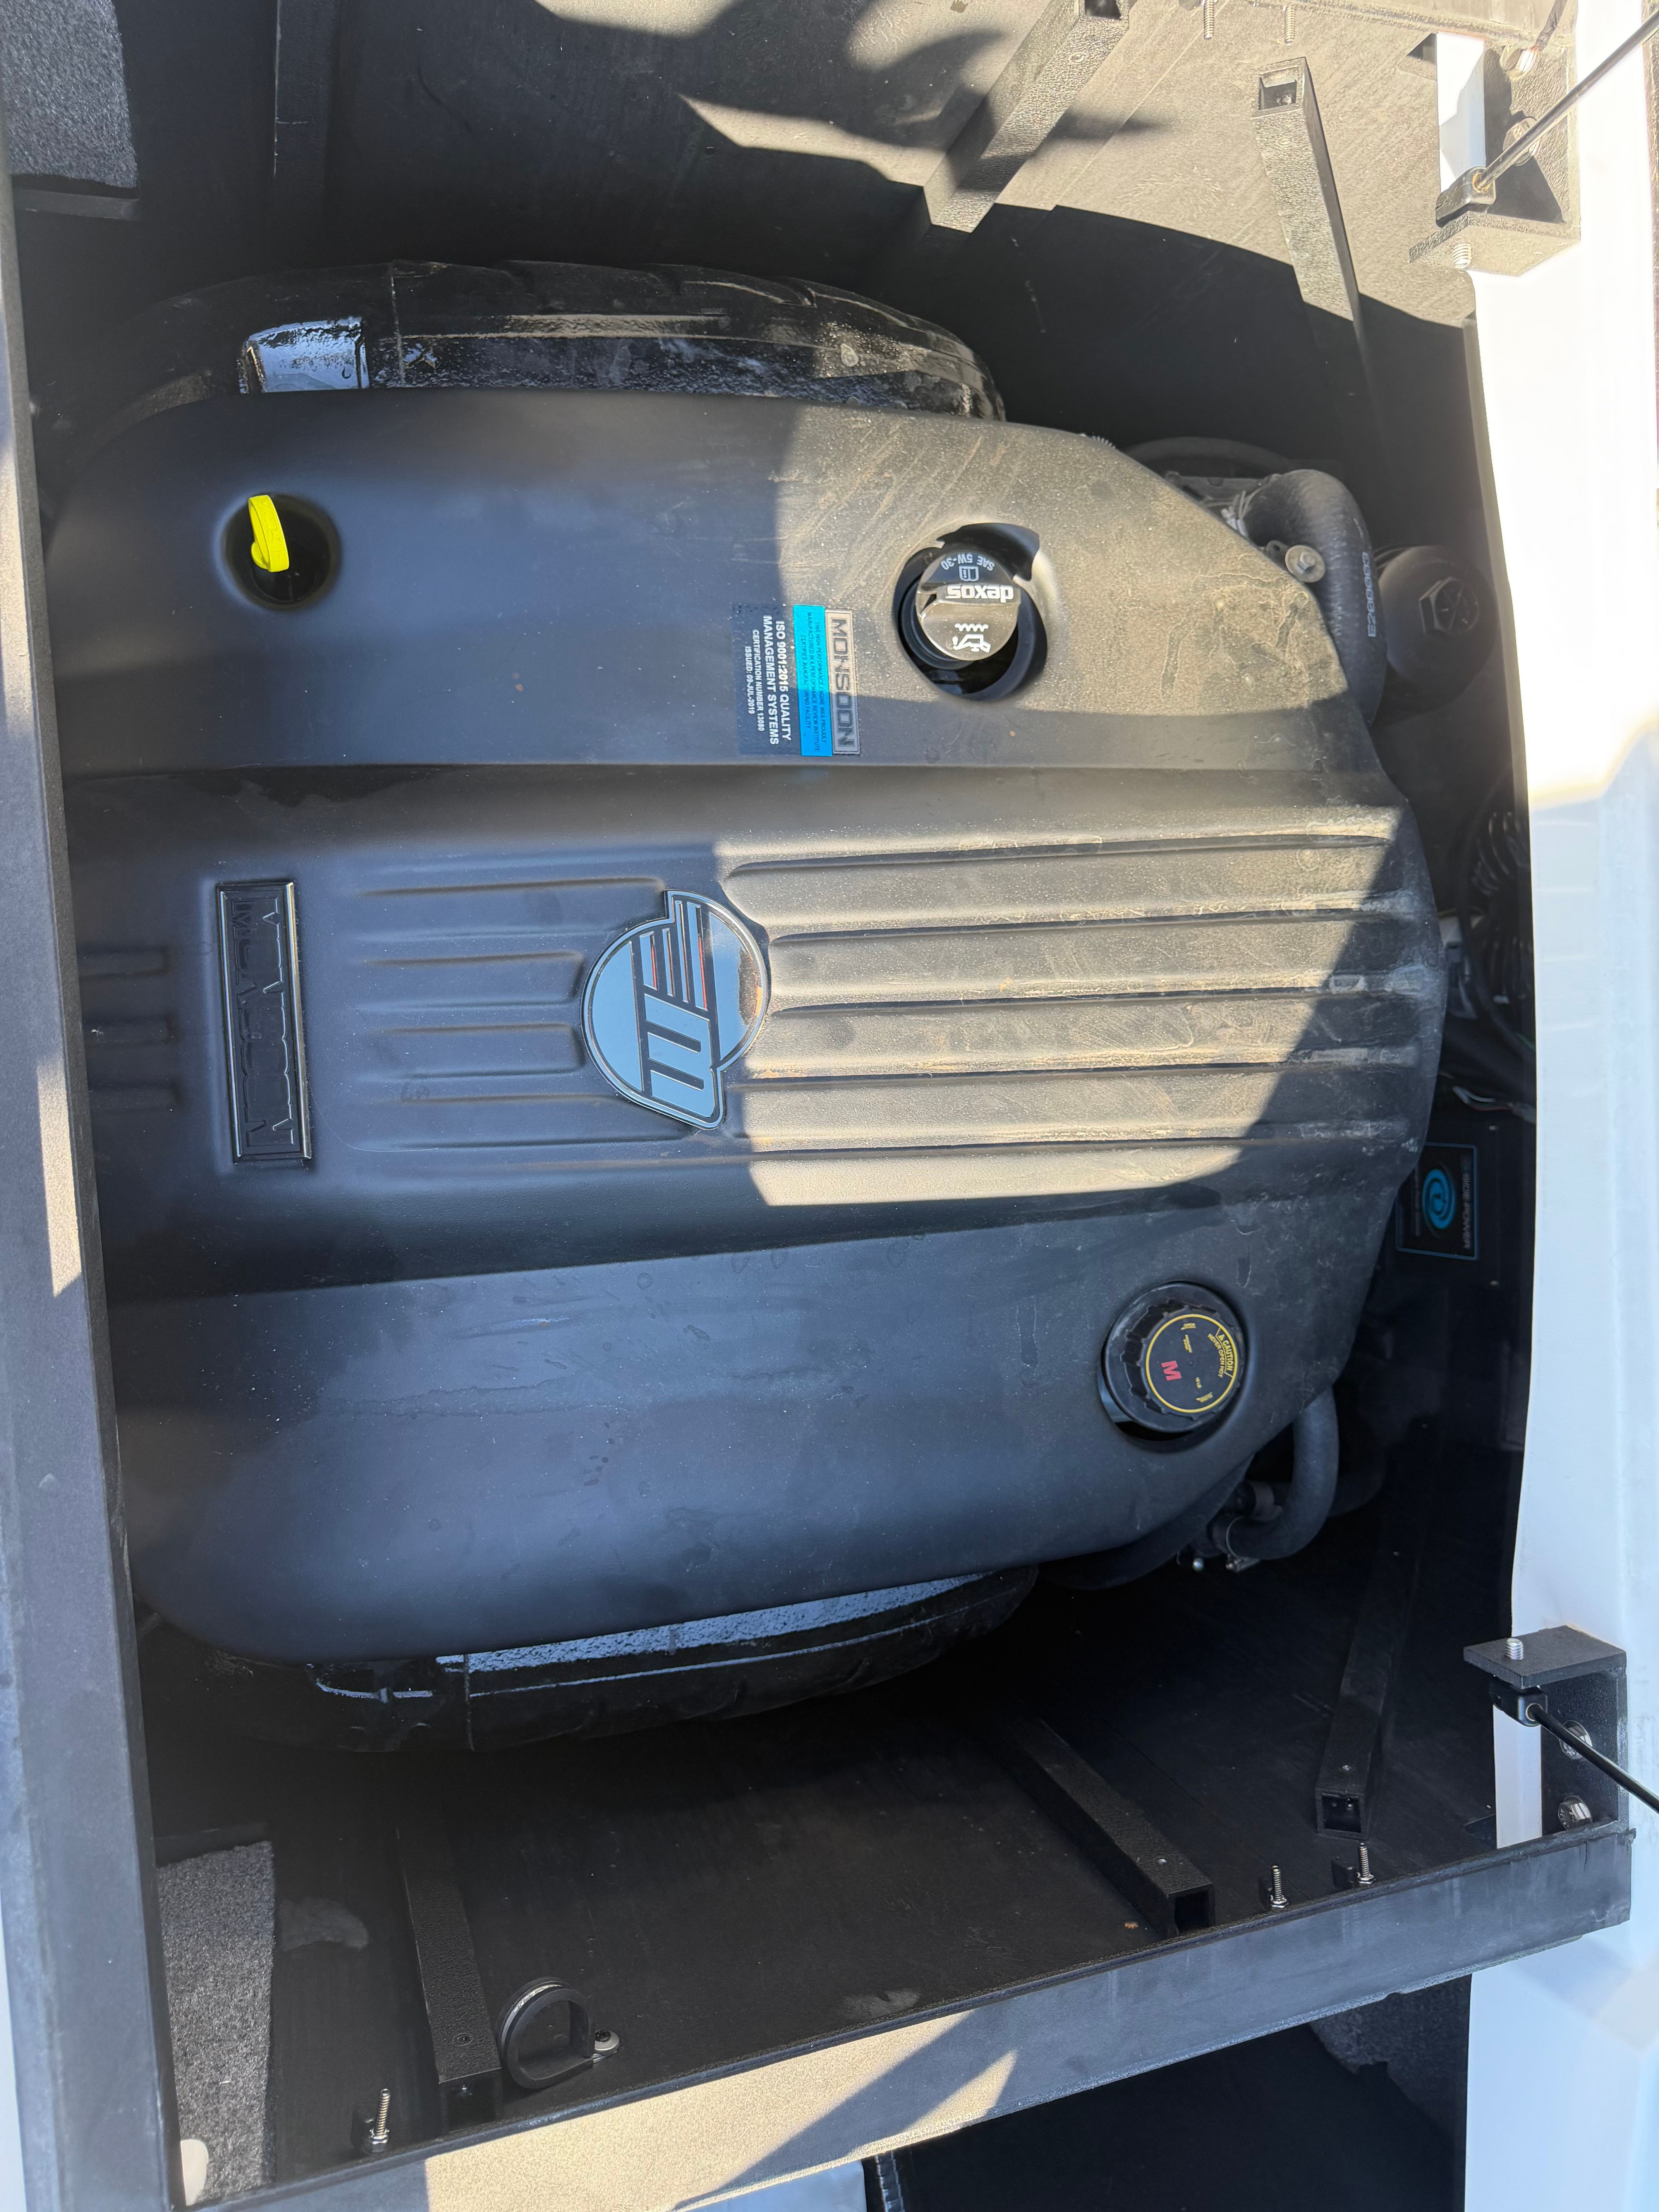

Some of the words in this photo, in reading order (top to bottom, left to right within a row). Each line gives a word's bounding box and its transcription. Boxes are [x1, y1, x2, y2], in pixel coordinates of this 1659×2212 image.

[941, 554, 973, 570] 5W-30
[977, 556, 995, 571] SAE
[947, 585, 1014, 603] dexos
[776, 621, 785, 639] ISO
[752, 629, 762, 680] CERTIFICATION
[763, 615, 775, 692] MANAGEMENT
[777, 642, 788, 692] 9001:2015
[756, 682, 764, 711] NUMBER
[831, 618, 855, 747] MONSOON
[767, 694, 778, 744] SYSTEMS
[780, 694, 791, 740] QUALITY
[1207, 1333, 1220, 1350] NEVER
[1223, 1340, 1233, 1370] CAUTION
[1161, 1360, 1182, 1381] M
